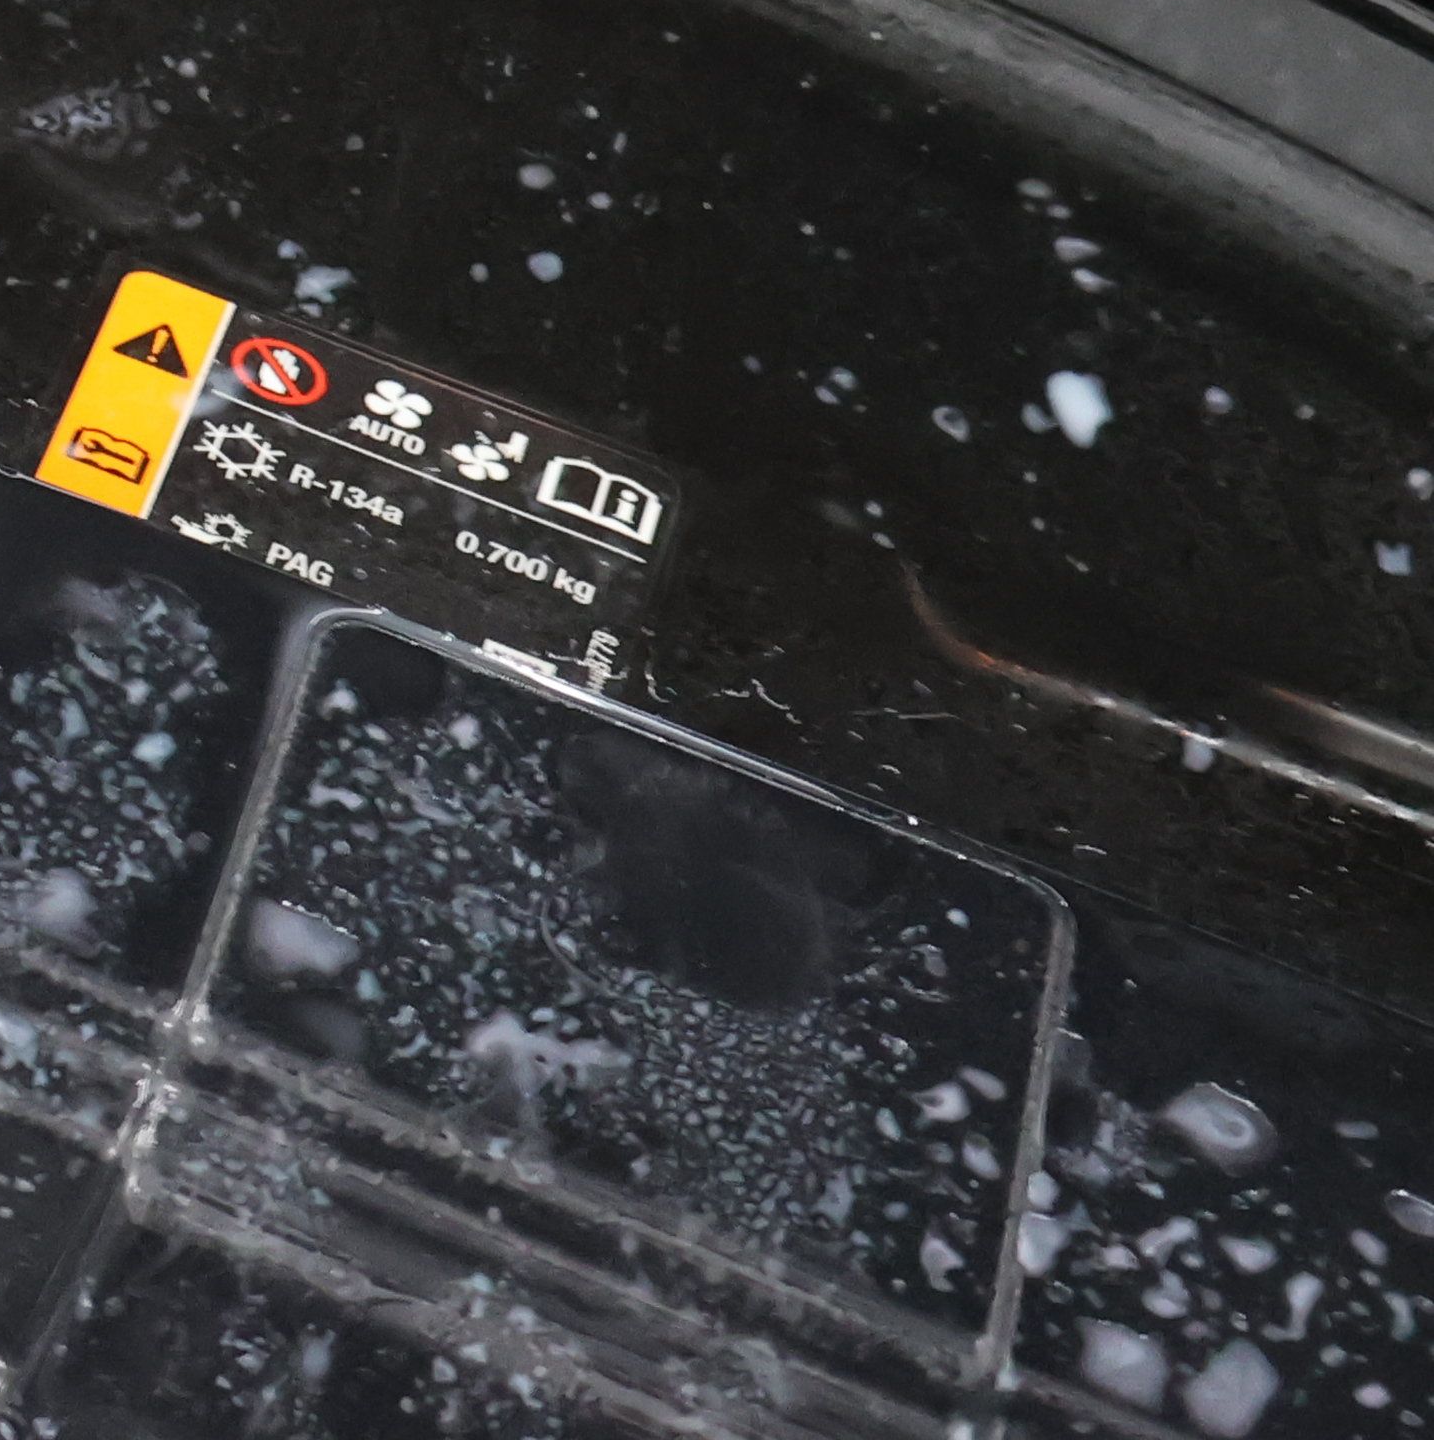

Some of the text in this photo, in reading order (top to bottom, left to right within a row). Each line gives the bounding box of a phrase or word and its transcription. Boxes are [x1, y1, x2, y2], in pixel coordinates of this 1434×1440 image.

[347, 414, 427, 456] AUTO
[288, 463, 597, 606] R-134a 0.700 kg
[264, 541, 335, 588] PAG
